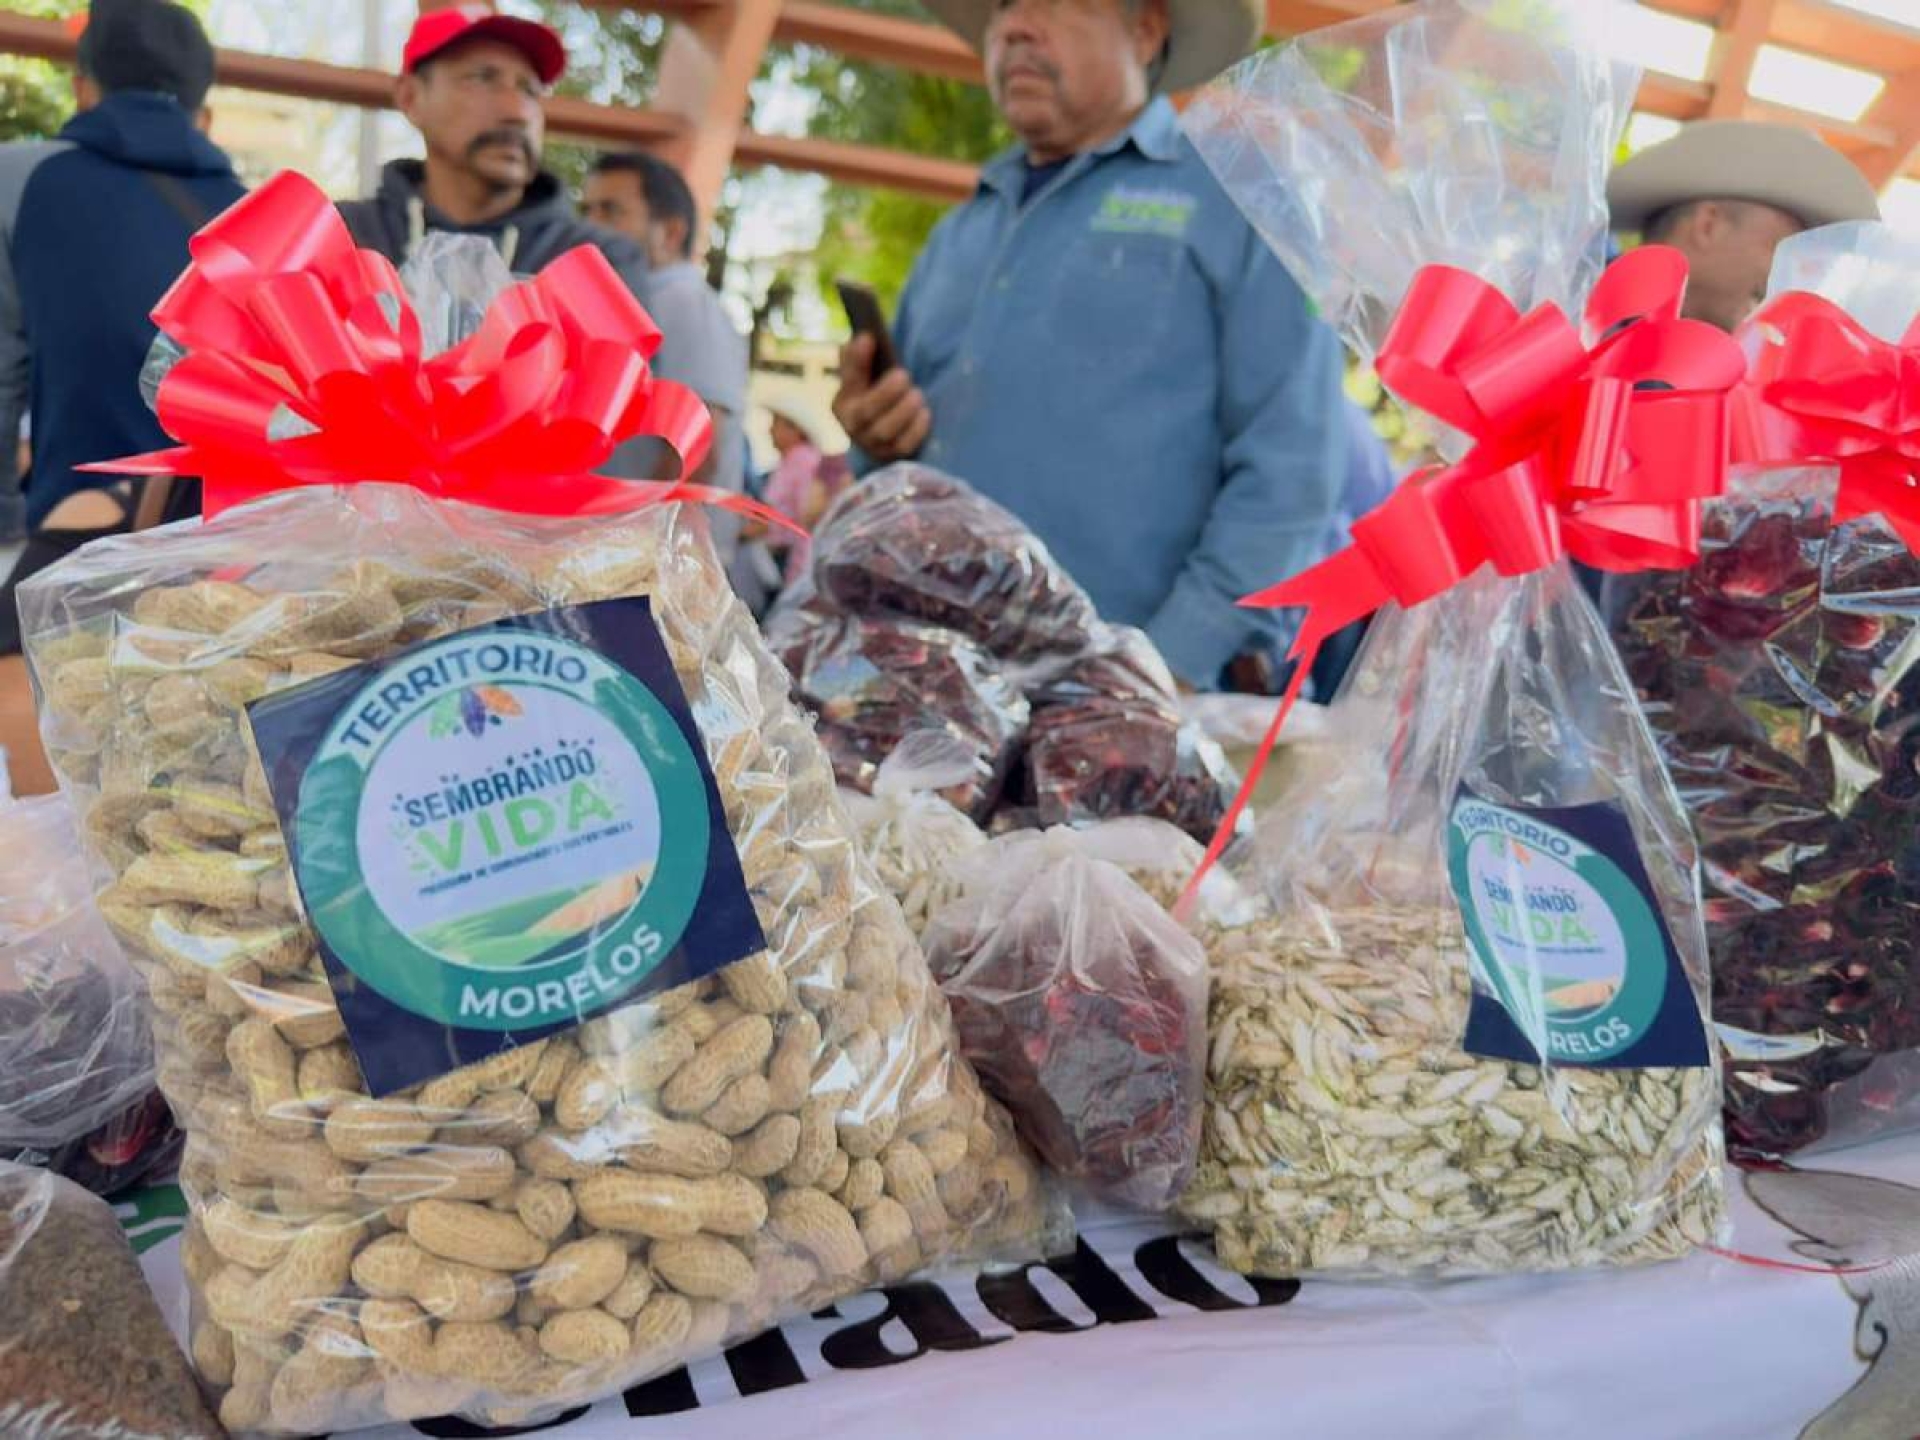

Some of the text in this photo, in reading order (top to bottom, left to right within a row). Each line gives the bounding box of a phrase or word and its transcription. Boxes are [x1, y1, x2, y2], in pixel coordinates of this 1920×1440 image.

[341, 644, 588, 751] TERRITORIO
[404, 748, 596, 827] SEMBRANDO
[416, 780, 614, 871] VIDA
[1484, 878, 1577, 912] SEMANDO
[1492, 902, 1593, 944] VDA
[460, 923, 662, 1019] MORELOS
[1549, 1015, 1632, 1054] RELOS
